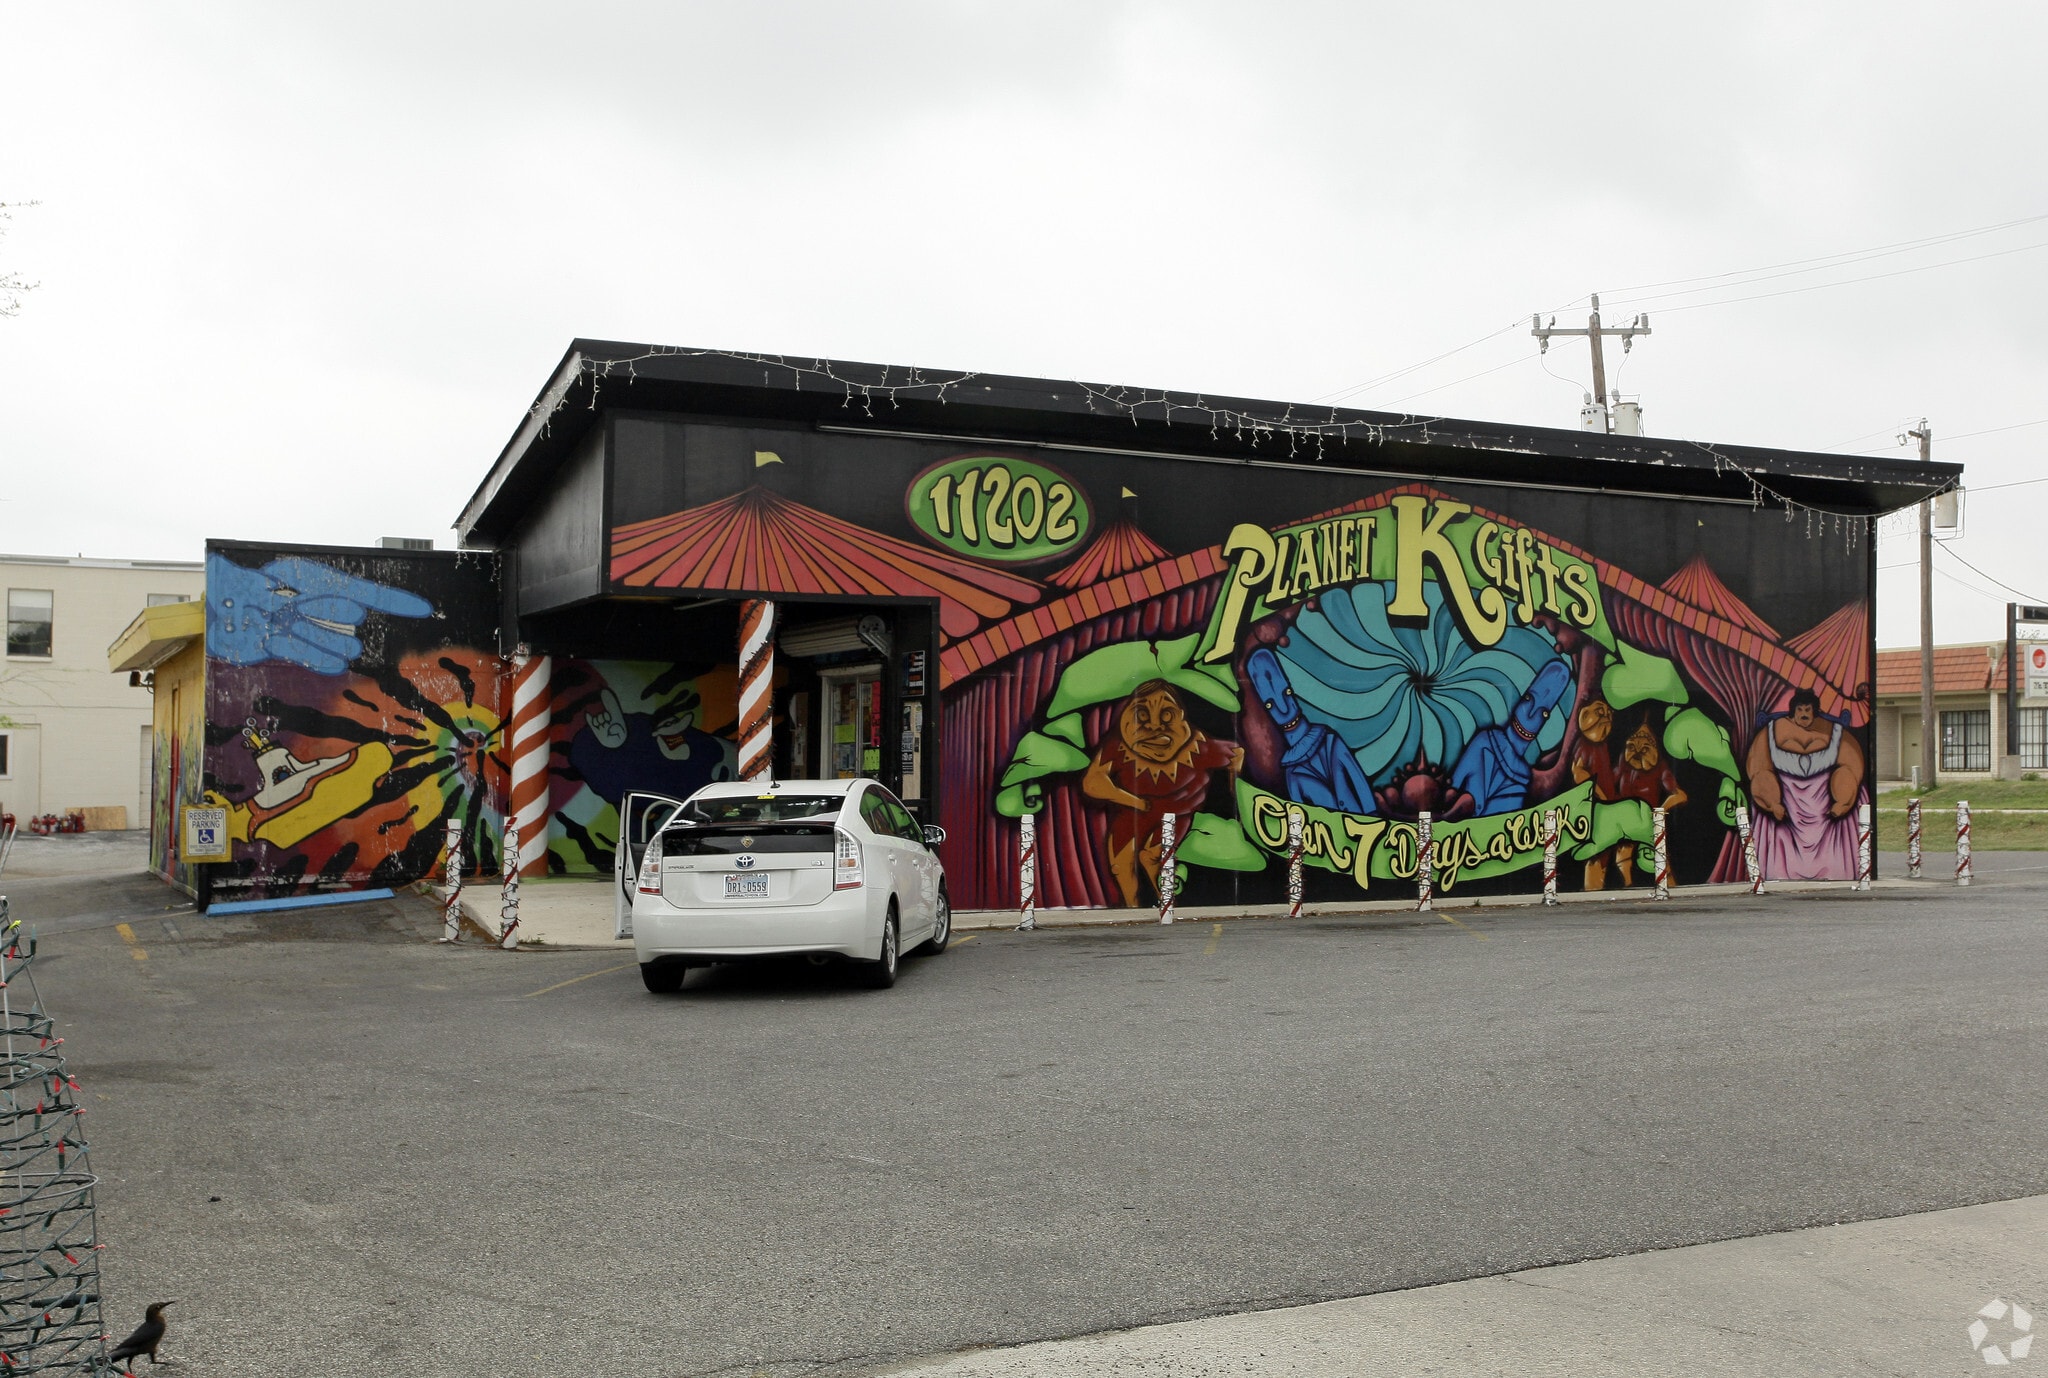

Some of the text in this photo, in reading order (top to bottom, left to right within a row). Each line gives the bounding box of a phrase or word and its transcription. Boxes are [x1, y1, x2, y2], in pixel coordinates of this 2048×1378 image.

[929, 466, 1077, 544] 11202
[1203, 495, 1598, 663] PLANET K Gifts
[189, 811, 222, 820] RESERVED
[192, 820, 220, 828] PARKING
[1344, 816, 1387, 890] 7
